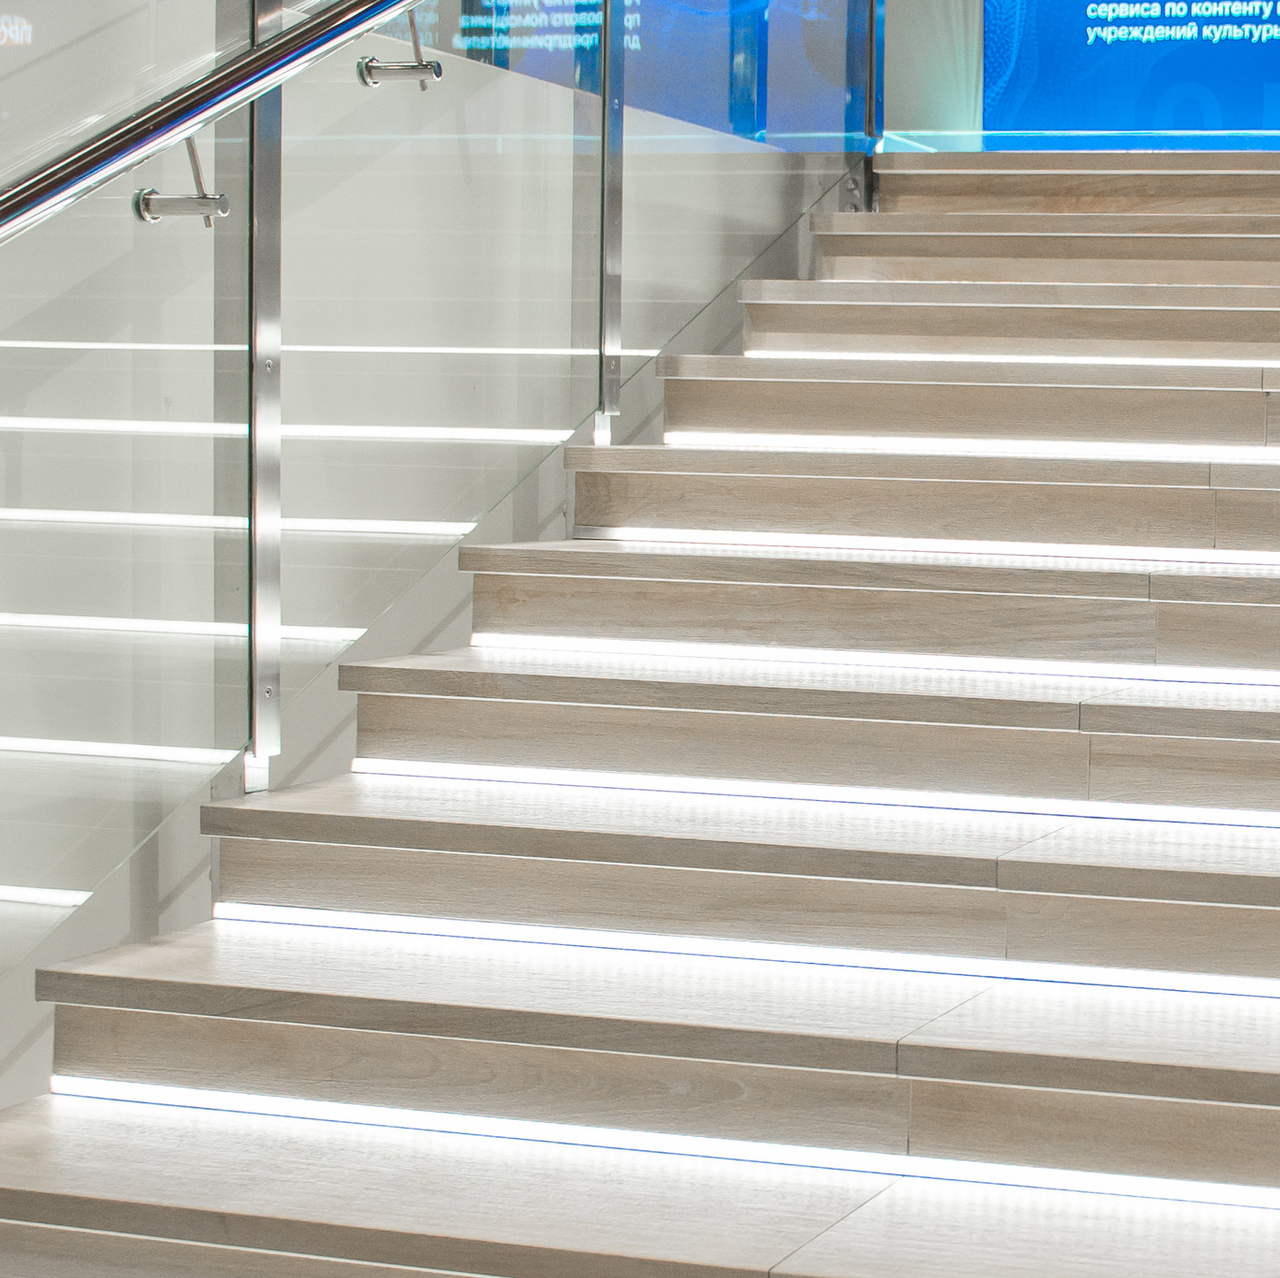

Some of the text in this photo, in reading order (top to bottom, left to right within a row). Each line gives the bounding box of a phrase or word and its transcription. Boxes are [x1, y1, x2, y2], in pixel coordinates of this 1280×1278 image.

[1086, 0, 1162, 21] сервиса
[1164, 0, 1188, 18] по
[1086, 22, 1198, 45] учреждений
